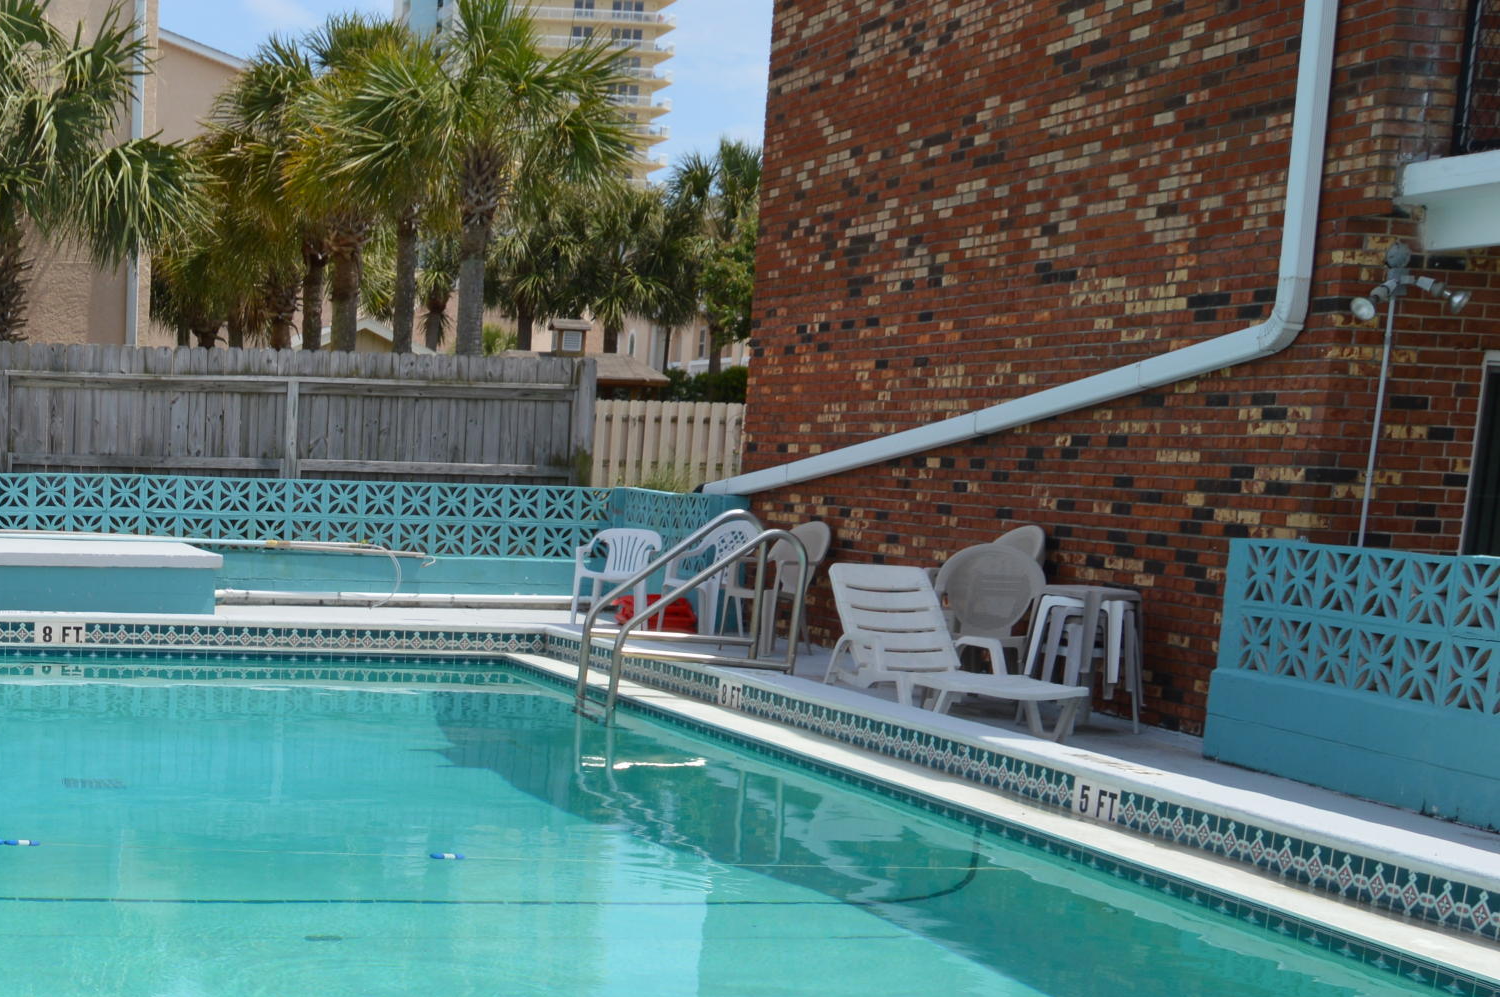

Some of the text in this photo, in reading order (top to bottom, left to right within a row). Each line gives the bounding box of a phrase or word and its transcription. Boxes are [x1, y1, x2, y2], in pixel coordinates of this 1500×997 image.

[42, 626, 83, 643] 8 FT.
[722, 684, 727, 704] 8
[1080, 785, 1118, 822] 5 FT.
